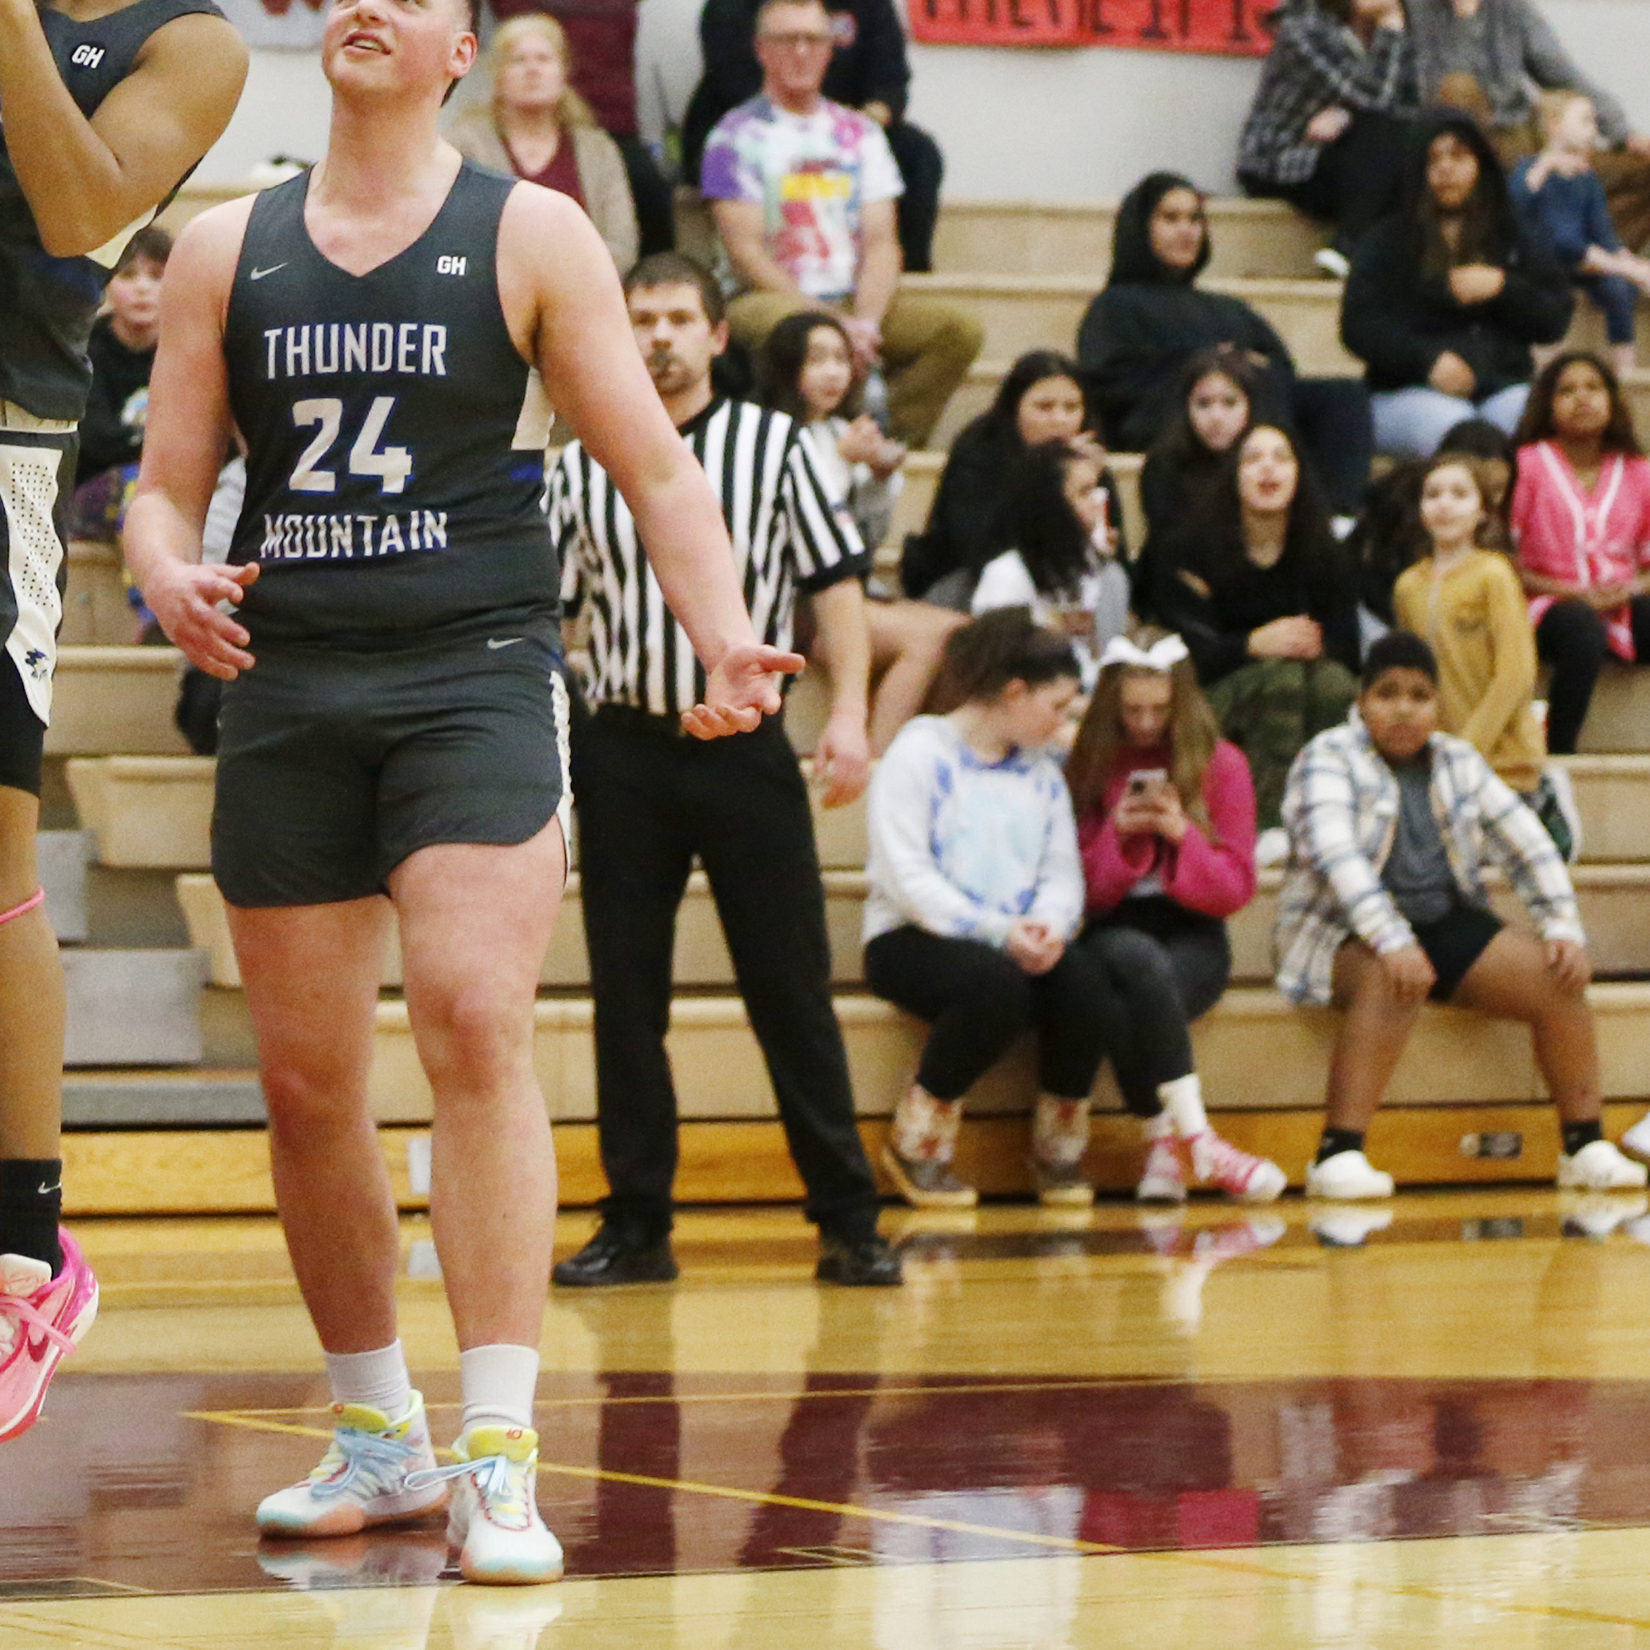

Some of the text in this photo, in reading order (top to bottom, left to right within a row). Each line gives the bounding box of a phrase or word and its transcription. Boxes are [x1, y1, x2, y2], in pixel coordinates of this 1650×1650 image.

[71, 45, 105, 69] GH
[436, 255, 467, 276] GH
[264, 323, 447, 379] THUNDER
[289, 396, 412, 494] 24
[260, 510, 448, 558] MOUNTAIN
